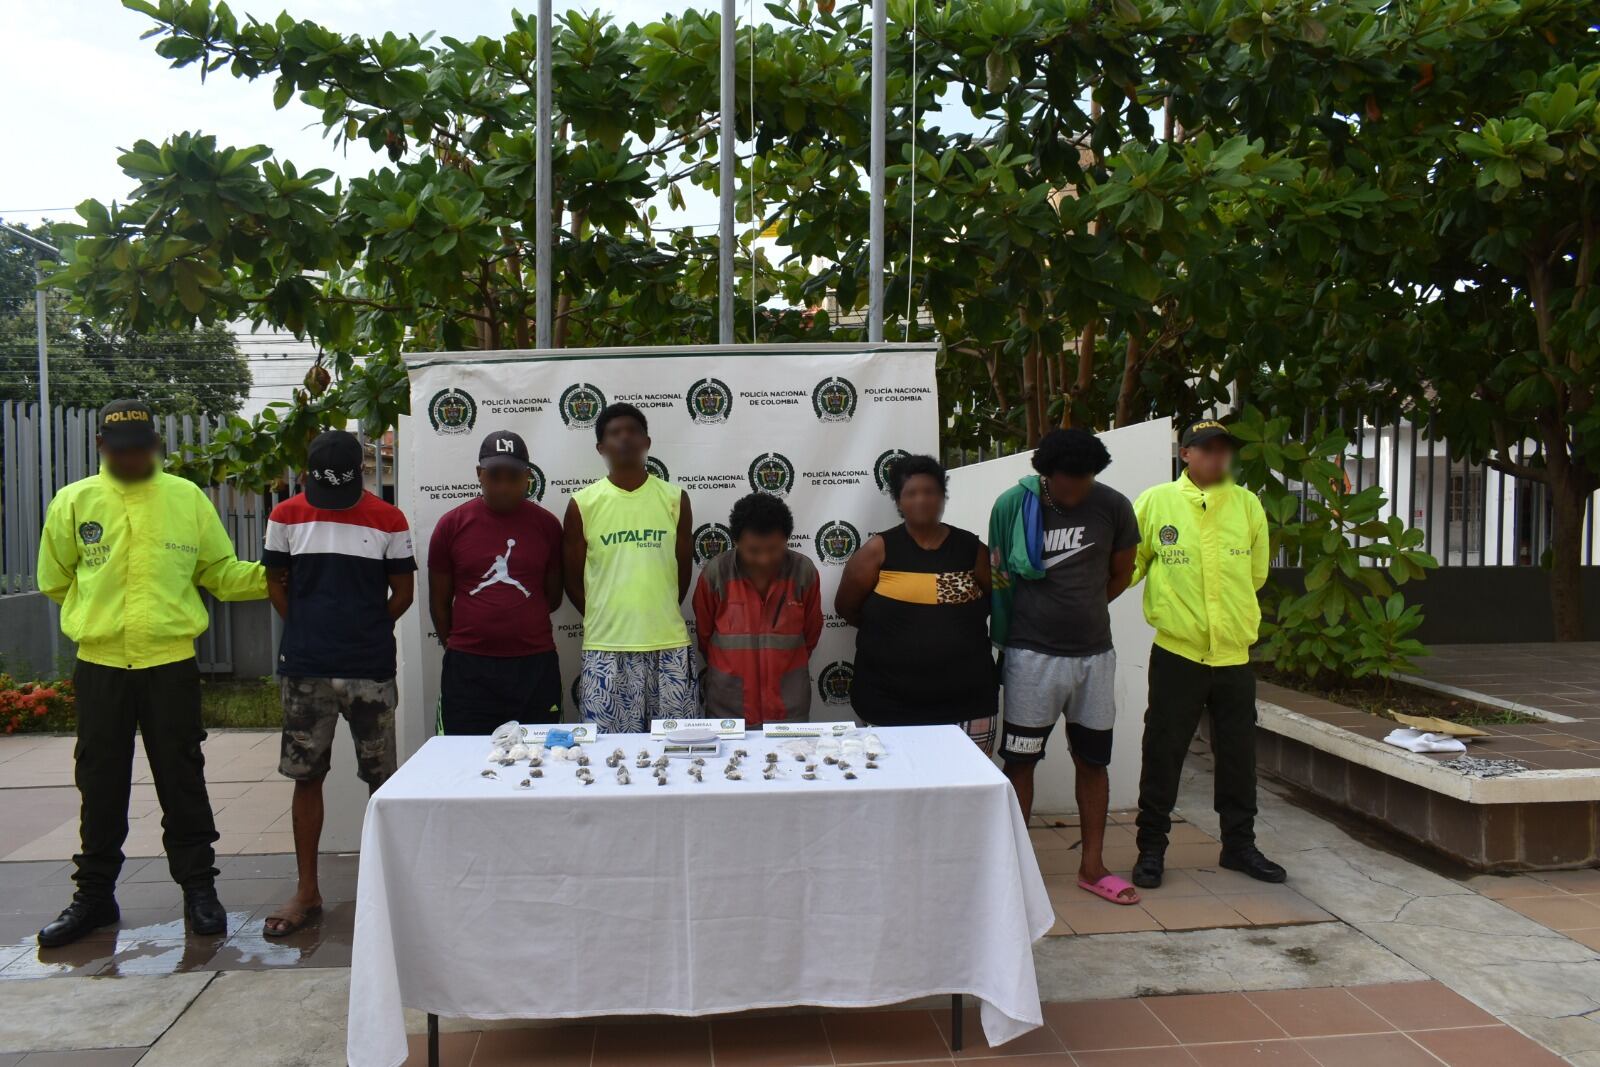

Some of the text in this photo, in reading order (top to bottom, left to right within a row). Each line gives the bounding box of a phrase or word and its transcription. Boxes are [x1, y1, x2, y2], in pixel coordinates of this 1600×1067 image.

[512, 397, 552, 405] NACIONAL
[635, 401, 674, 409] COLOMBIA
[104, 410, 149, 424] POLICIA
[451, 483, 482, 491] NACION
[441, 491, 482, 499] COLOMBIA
[600, 529, 667, 546] VITALFIT
[1042, 526, 1086, 552] NIKE
